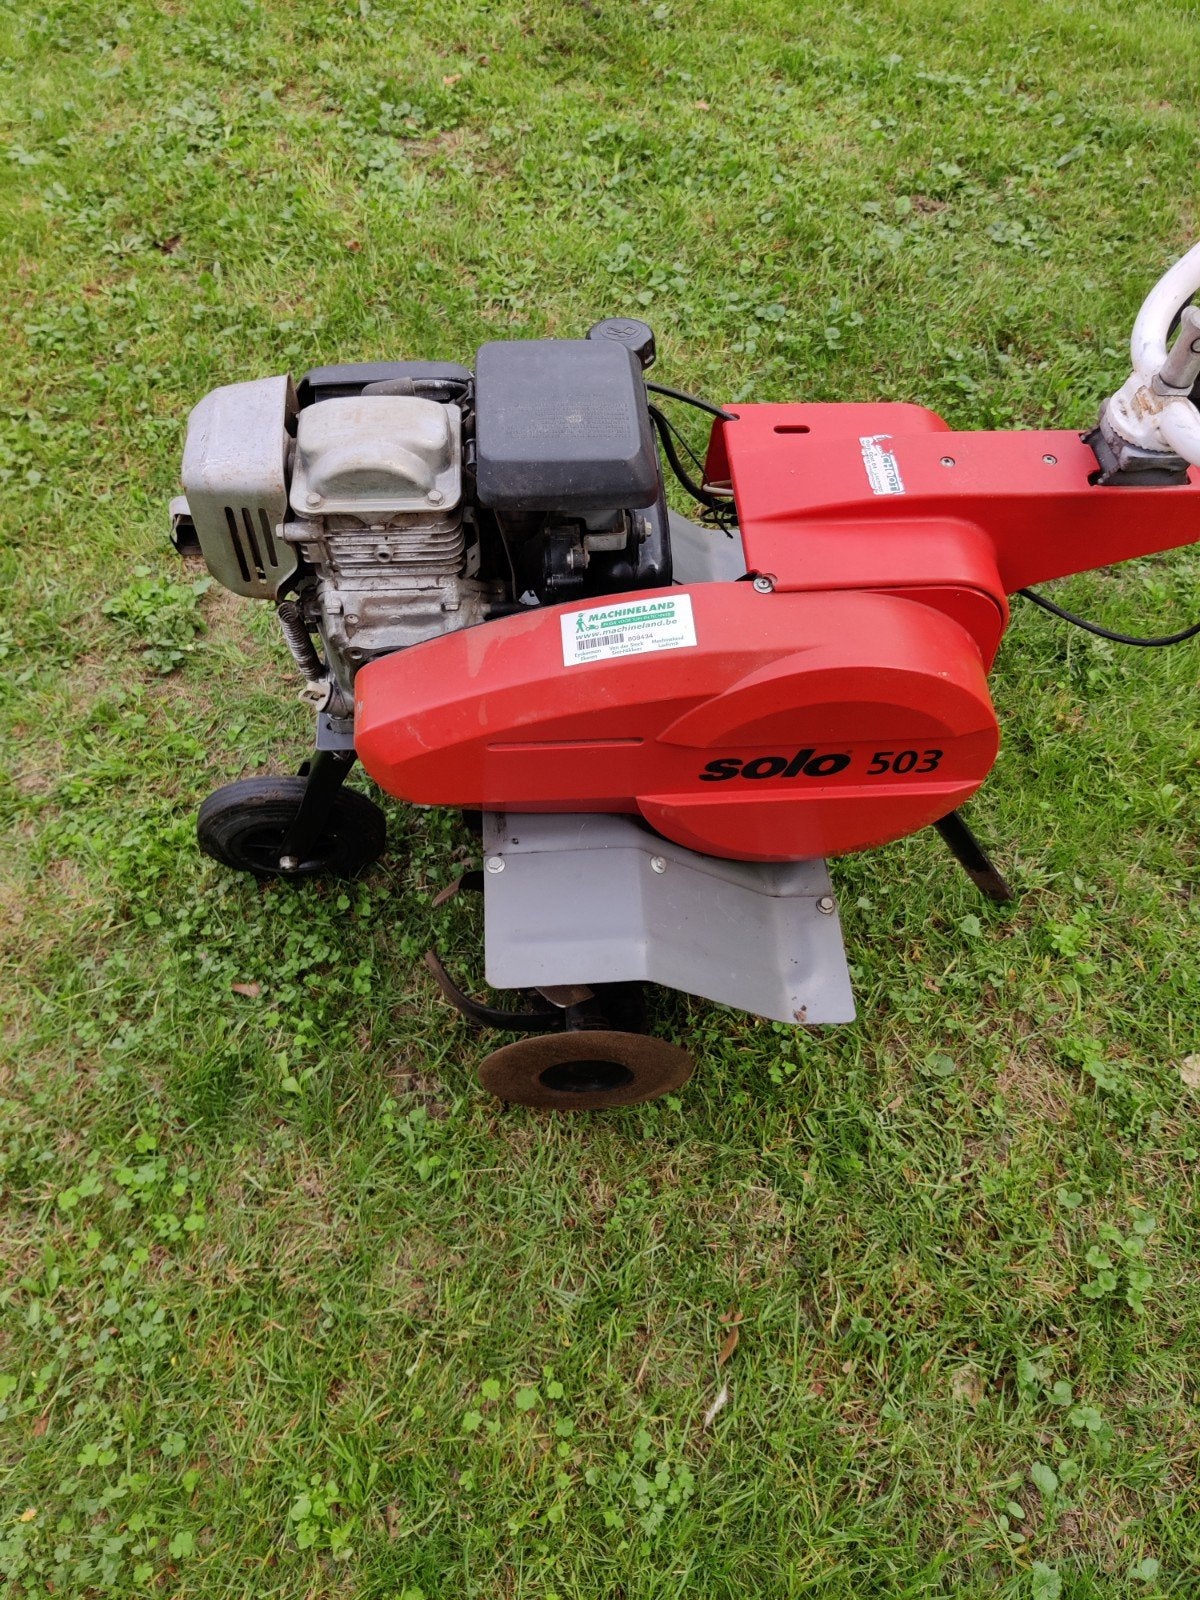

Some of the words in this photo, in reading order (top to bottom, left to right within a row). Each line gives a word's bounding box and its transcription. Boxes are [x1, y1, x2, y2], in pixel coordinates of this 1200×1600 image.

[588, 601, 675, 622] MACHINELAND
[575, 618, 678, 640] www.machineland.be
[698, 749, 851, 782] solo
[866, 750, 943, 775] 503
